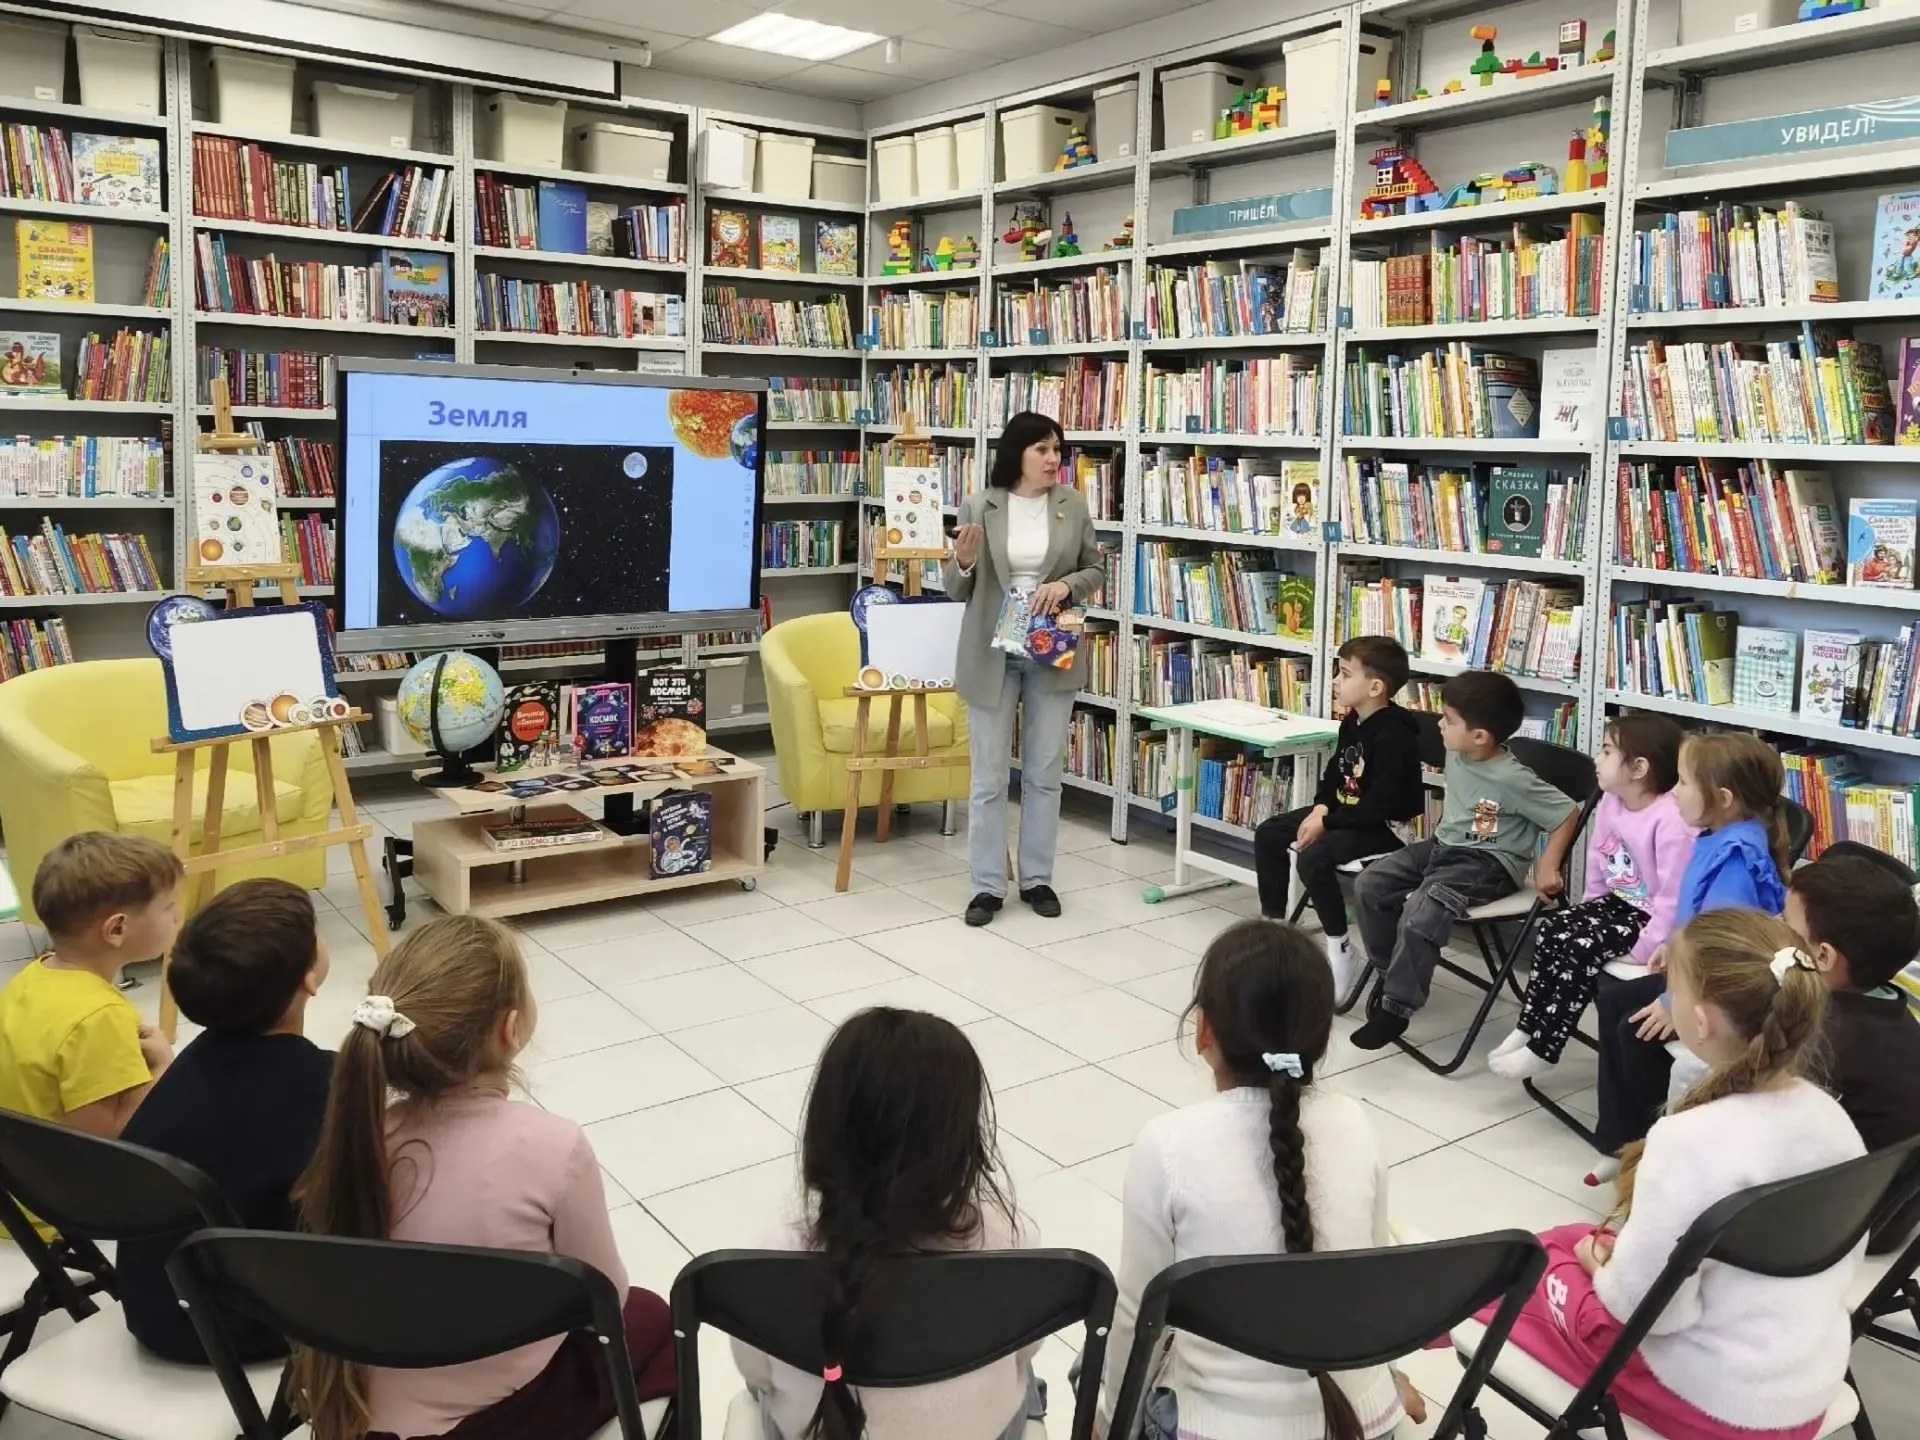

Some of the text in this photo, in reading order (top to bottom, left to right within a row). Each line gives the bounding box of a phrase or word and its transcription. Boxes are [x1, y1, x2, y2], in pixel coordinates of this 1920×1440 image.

[1780, 115, 1876, 145] УВИДЕЛ!
[1228, 204, 1278, 223] ПРИШЁЛ!
[428, 400, 528, 429] Земля
[1494, 480, 1540, 490] СКАЗКА
[652, 678, 687, 686] ВОТ ЭТО
[649, 685, 691, 696] КОСМОС!
[589, 713, 619, 724] КОСМОС
